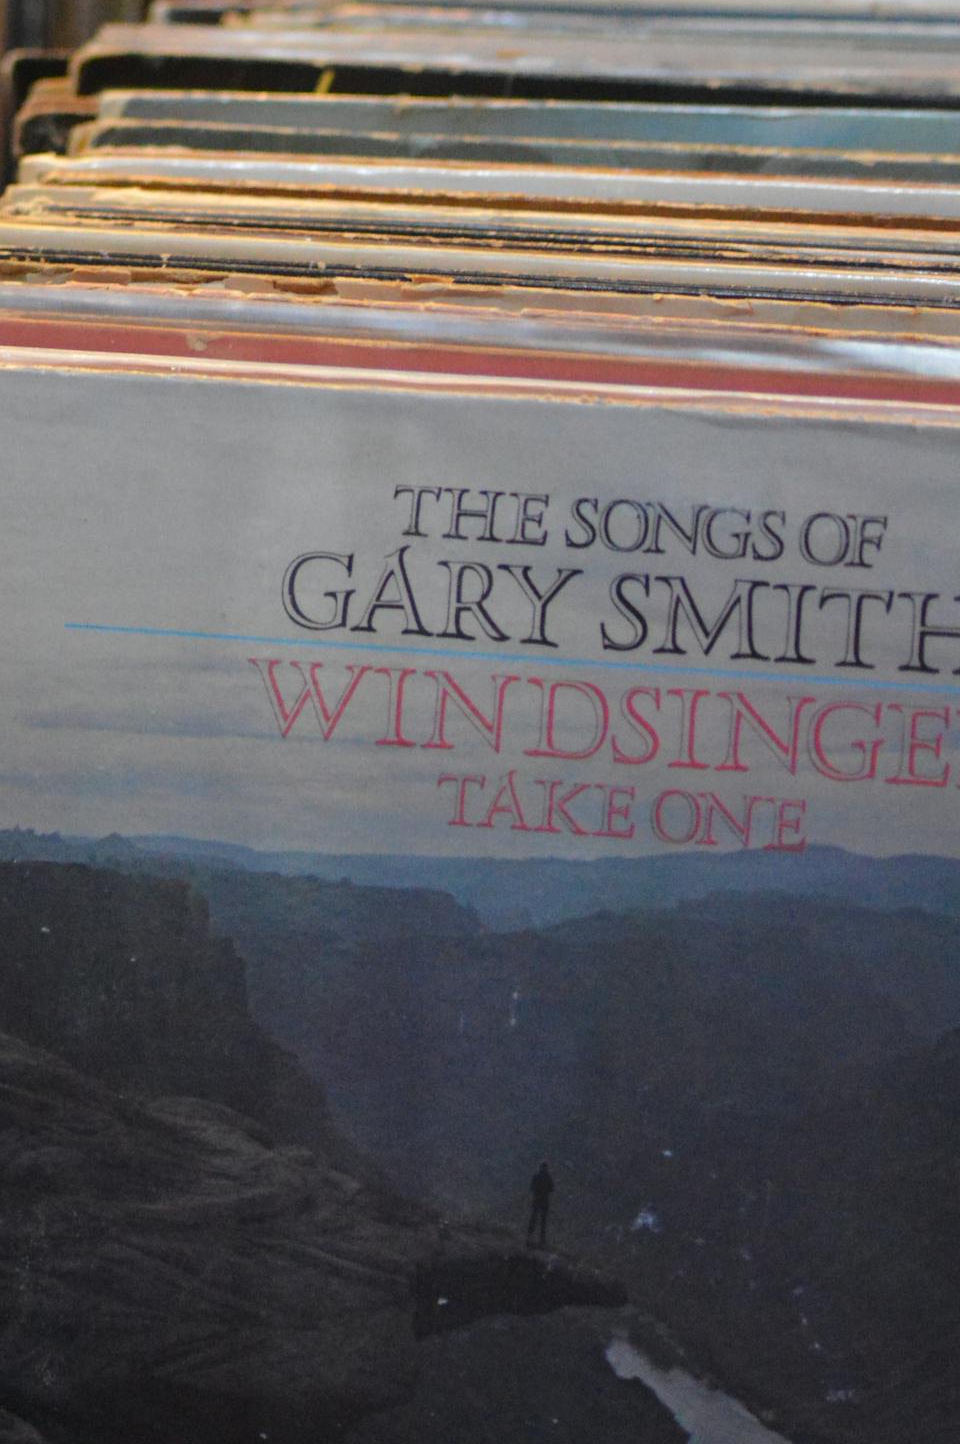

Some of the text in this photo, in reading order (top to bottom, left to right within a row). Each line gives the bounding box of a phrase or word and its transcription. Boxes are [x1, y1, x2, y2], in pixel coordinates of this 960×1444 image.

[393, 484, 888, 568] THE SONGS OF
[281, 544, 960, 675] GARY SMITH
[247, 657, 960, 789] WINDSINGE
[437, 769, 808, 853] TAKE ONE
